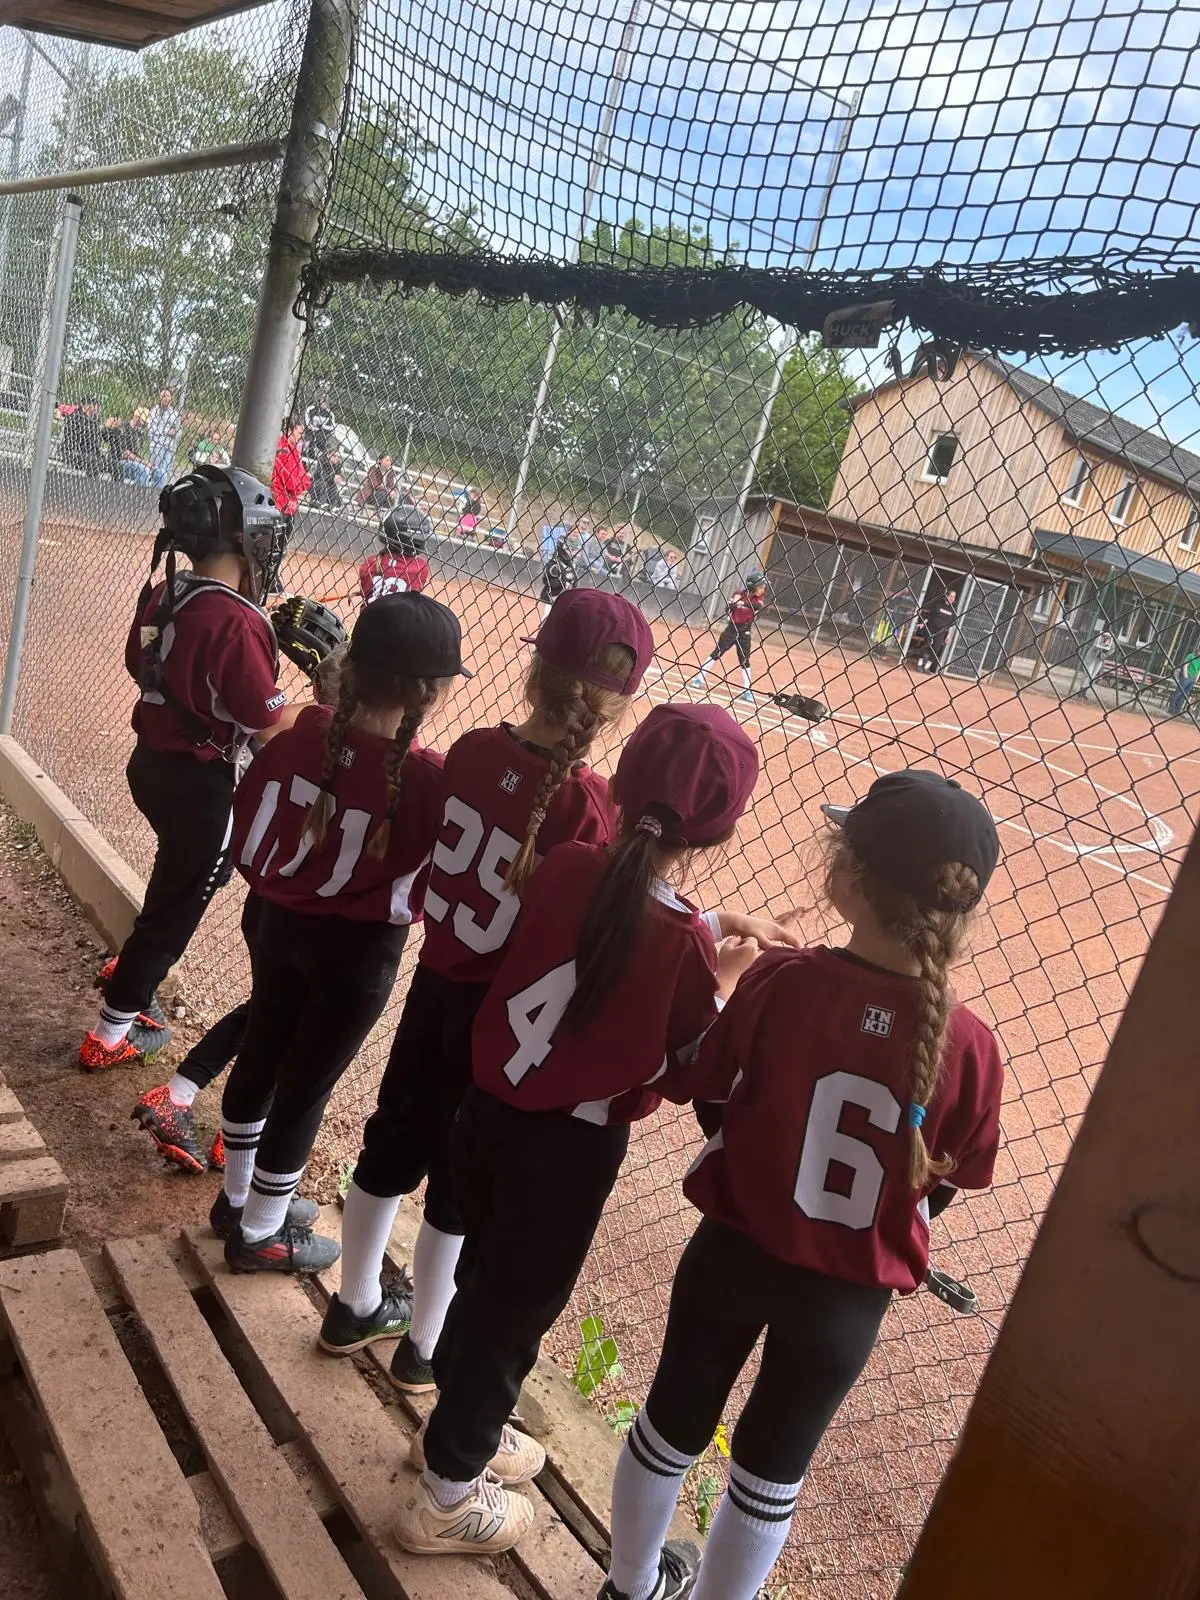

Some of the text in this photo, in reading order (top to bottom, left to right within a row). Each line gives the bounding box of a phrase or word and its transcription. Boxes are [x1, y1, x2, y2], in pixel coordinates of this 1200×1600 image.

[829, 323, 870, 337] HUCK
[501, 778, 514, 792] KD
[506, 769, 520, 784] TN
[423, 795, 545, 955] 25
[502, 959, 577, 1087] 4
[867, 1006, 893, 1025] TN
[863, 1018, 890, 1036] KD
[793, 1071, 901, 1230] 6
